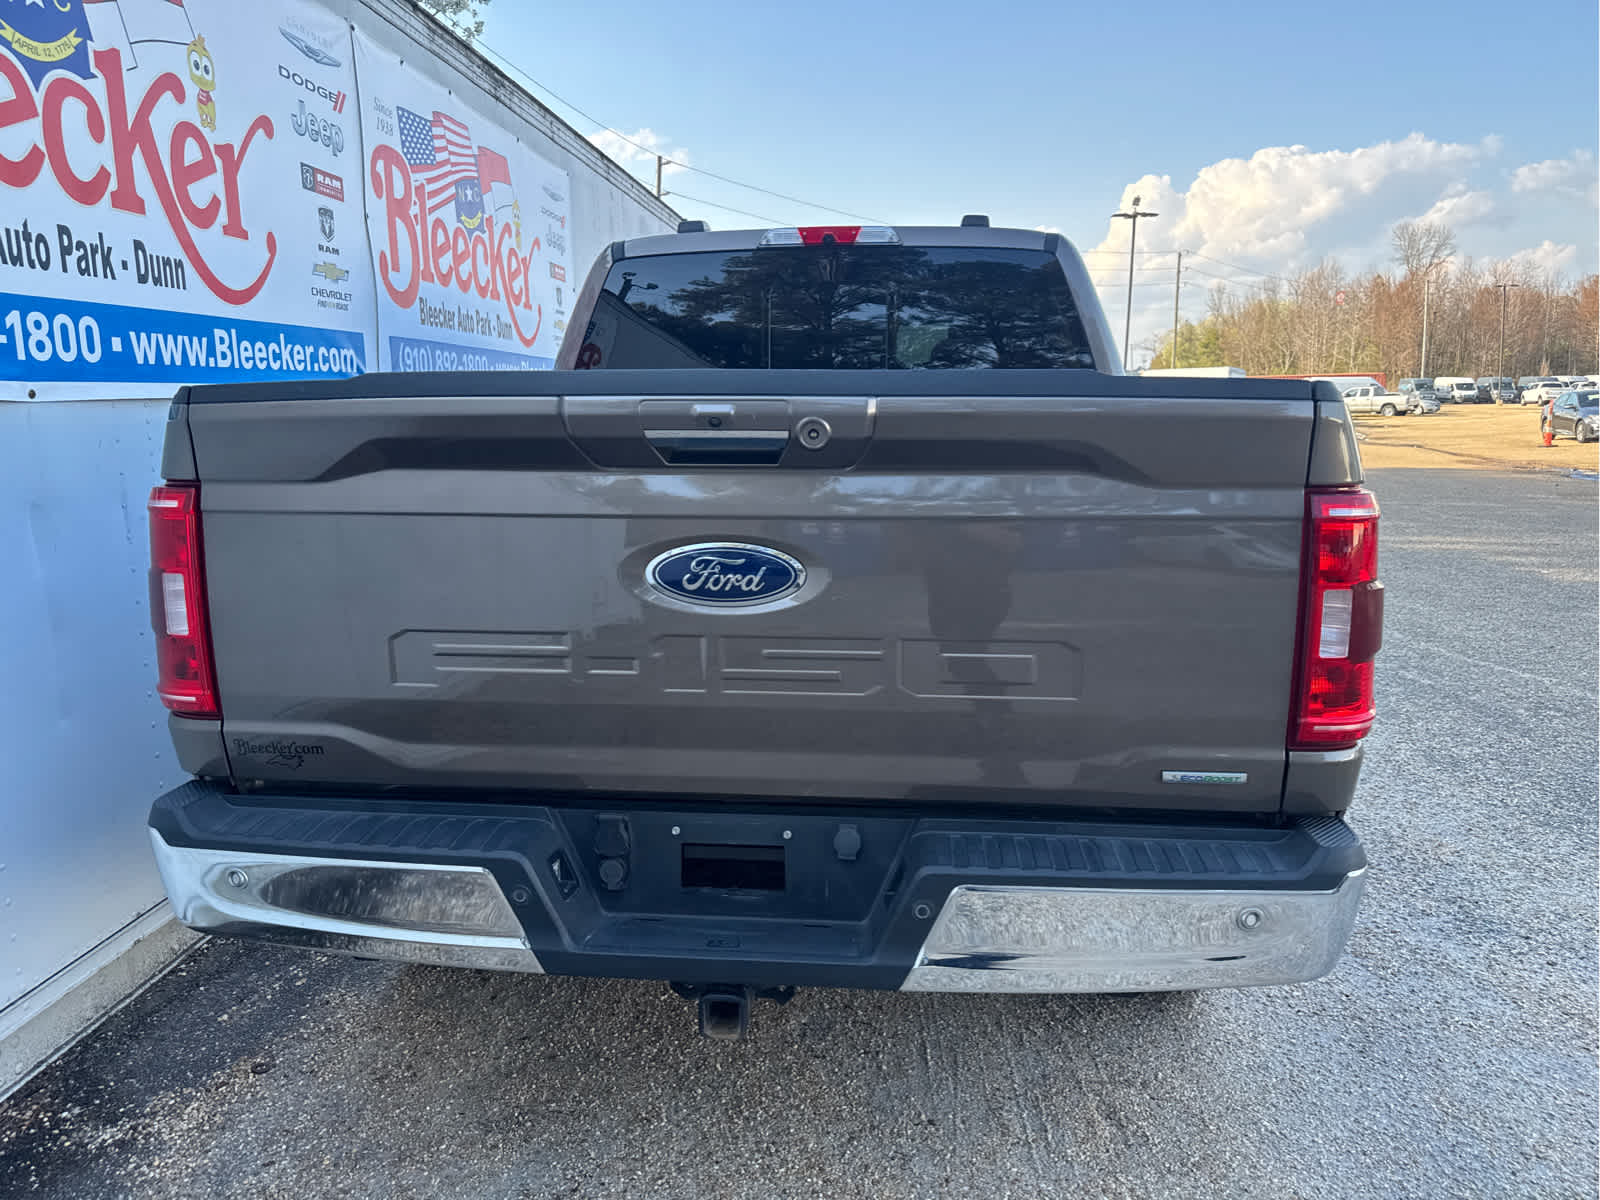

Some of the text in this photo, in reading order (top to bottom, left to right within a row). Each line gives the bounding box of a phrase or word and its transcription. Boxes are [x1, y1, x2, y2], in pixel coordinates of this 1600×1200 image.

[15, 38, 41, 57] APRIL
[278, 63, 339, 105] DODGE
[291, 98, 344, 157] Jeep
[315, 172, 342, 191] RAM
[57, 223, 117, 281] Park
[133, 239, 187, 291] Dunn
[318, 244, 340, 256] RAM
[370, 143, 542, 349] Bleecker
[311, 287, 352, 302] CHEVROLET
[419, 296, 455, 331] Bleecker
[457, 304, 475, 334] Auto
[475, 309, 492, 337] Park
[129, 328, 358, 374] www.Bleecker.com
[681, 556, 768, 592] Ford
[388, 629, 1083, 704] F-150
